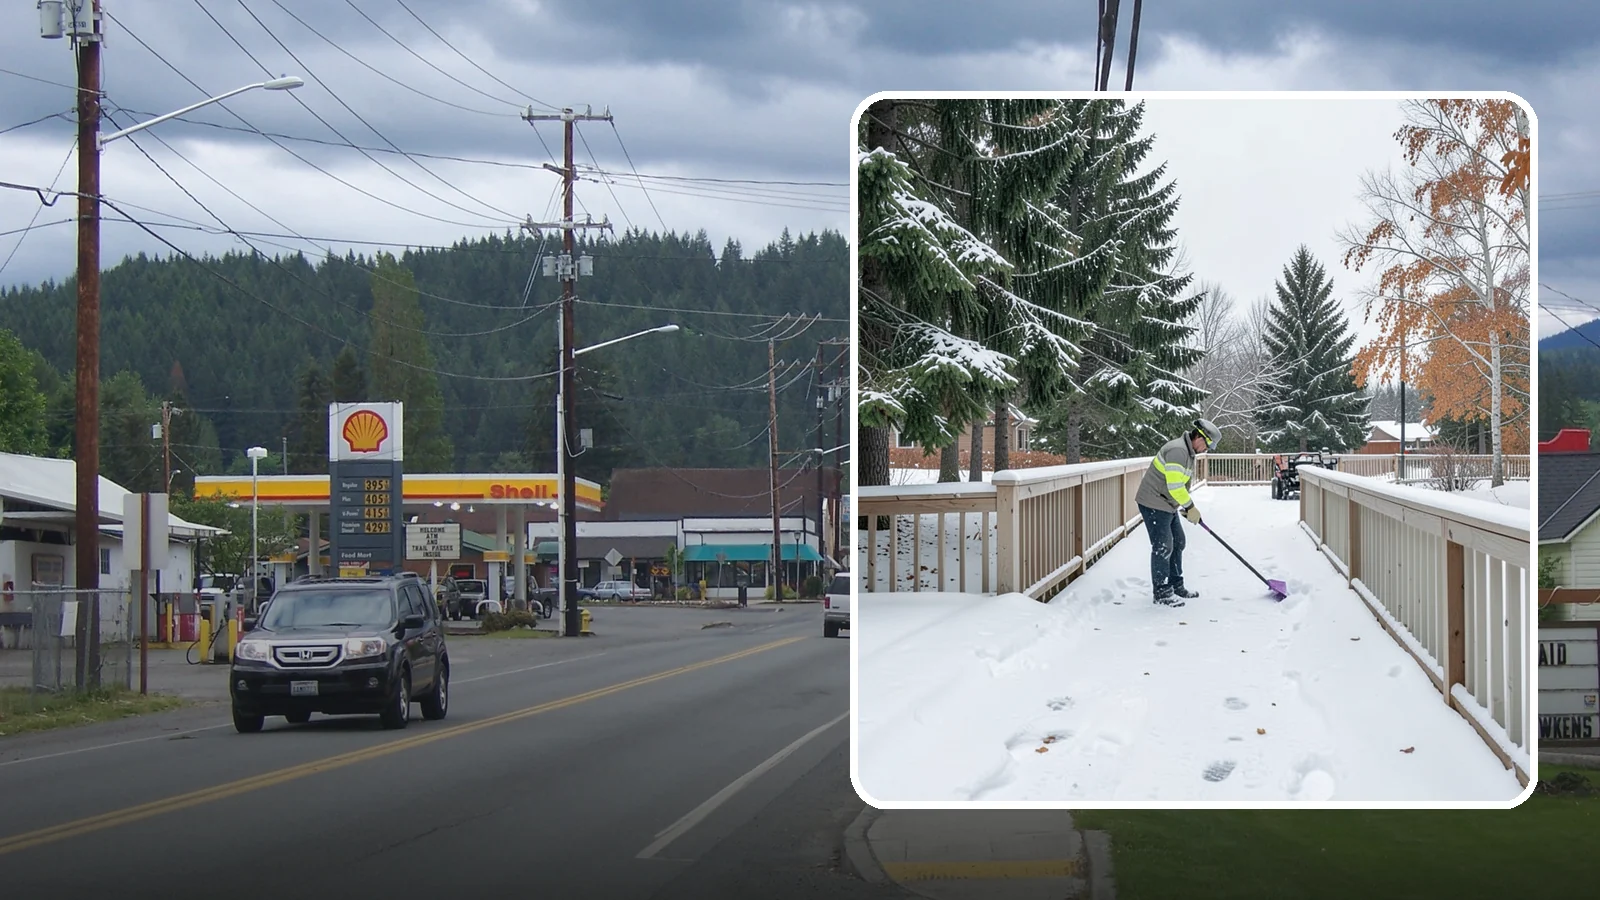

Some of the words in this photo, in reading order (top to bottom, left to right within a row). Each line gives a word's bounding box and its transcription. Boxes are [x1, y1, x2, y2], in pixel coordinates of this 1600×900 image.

[366, 480, 383, 490] 395
[490, 484, 547, 499] Shell
[366, 494, 383, 504] 405
[366, 508, 383, 518] 415
[366, 522, 383, 532] 429
